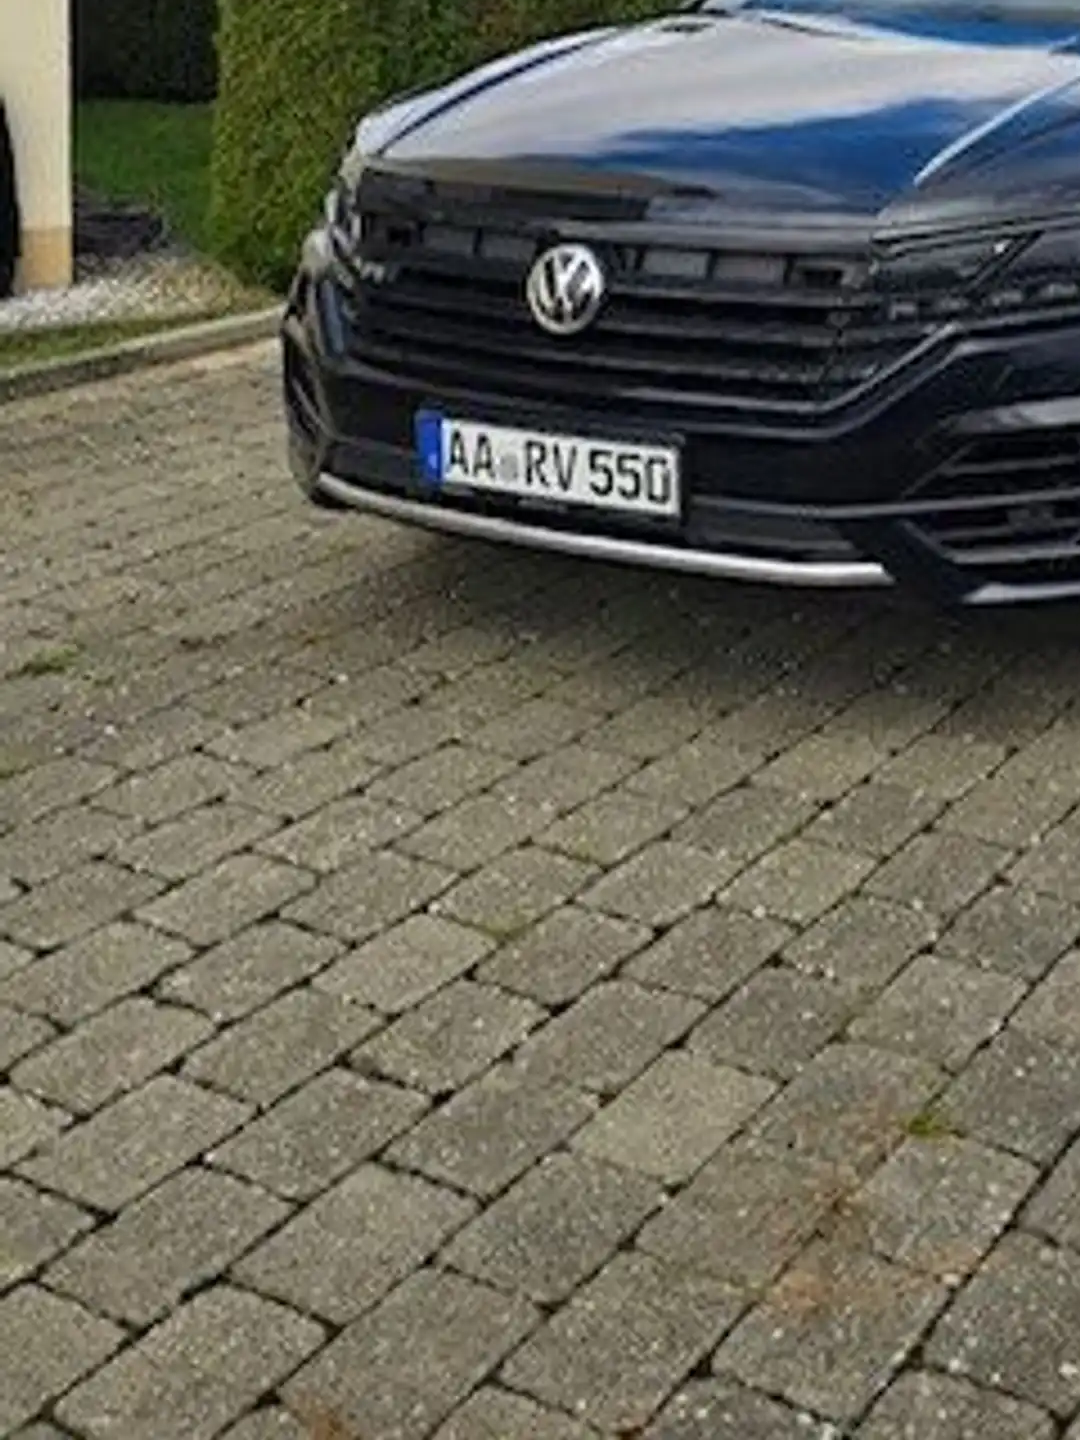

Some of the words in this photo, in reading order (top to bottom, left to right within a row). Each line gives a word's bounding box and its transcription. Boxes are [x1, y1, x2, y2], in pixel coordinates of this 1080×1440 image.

[527, 244, 604, 335] VW
[449, 428, 496, 481] AA
[524, 439, 578, 492] RV
[589, 448, 671, 505] 550
